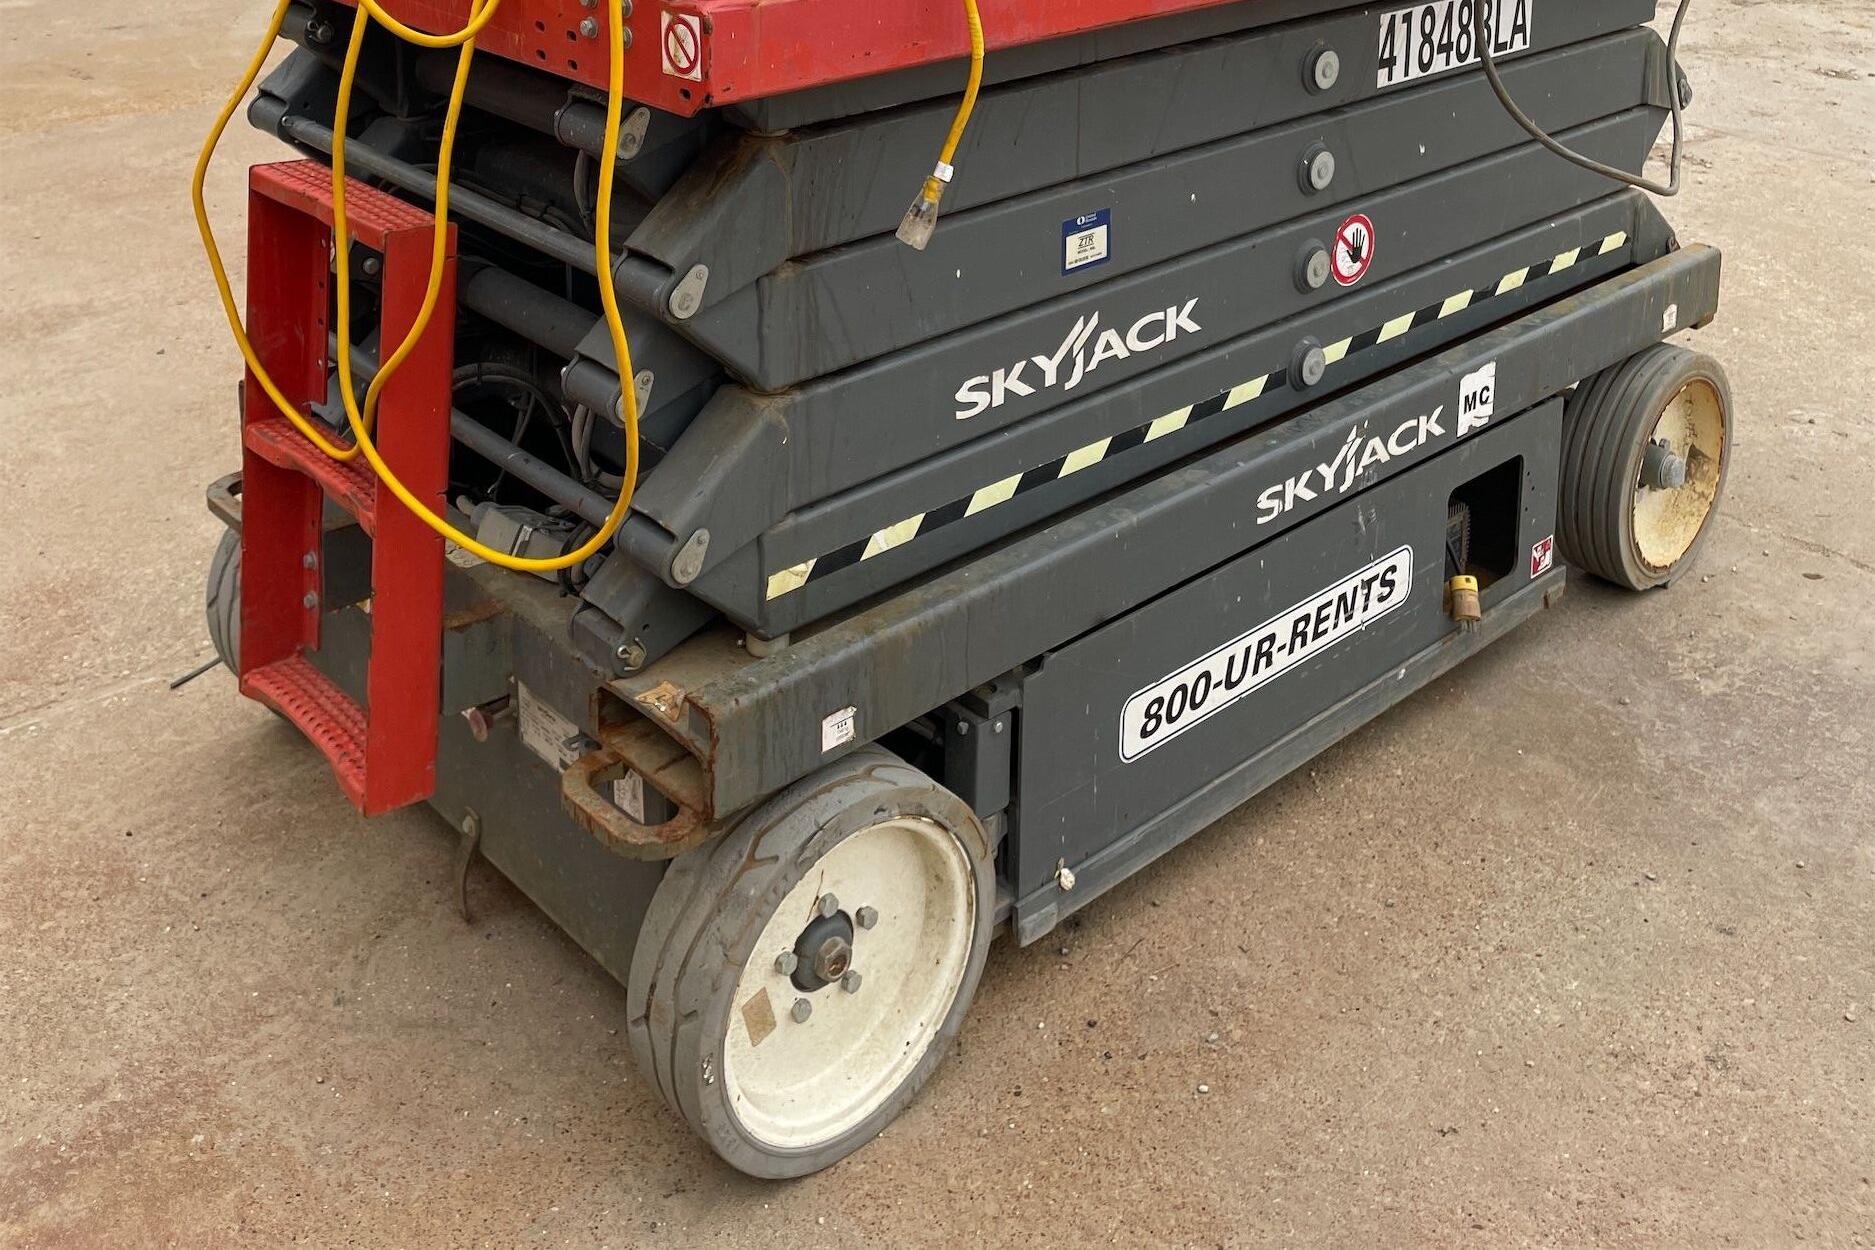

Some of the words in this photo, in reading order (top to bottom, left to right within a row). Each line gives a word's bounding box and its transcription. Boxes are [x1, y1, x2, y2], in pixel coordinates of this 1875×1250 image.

[953, 297, 1202, 420] SKYJACK
[1463, 385, 1490, 415] MC
[1256, 404, 1447, 525] SKYJACK
[1139, 564, 1397, 740] 800-UR-RENTS
